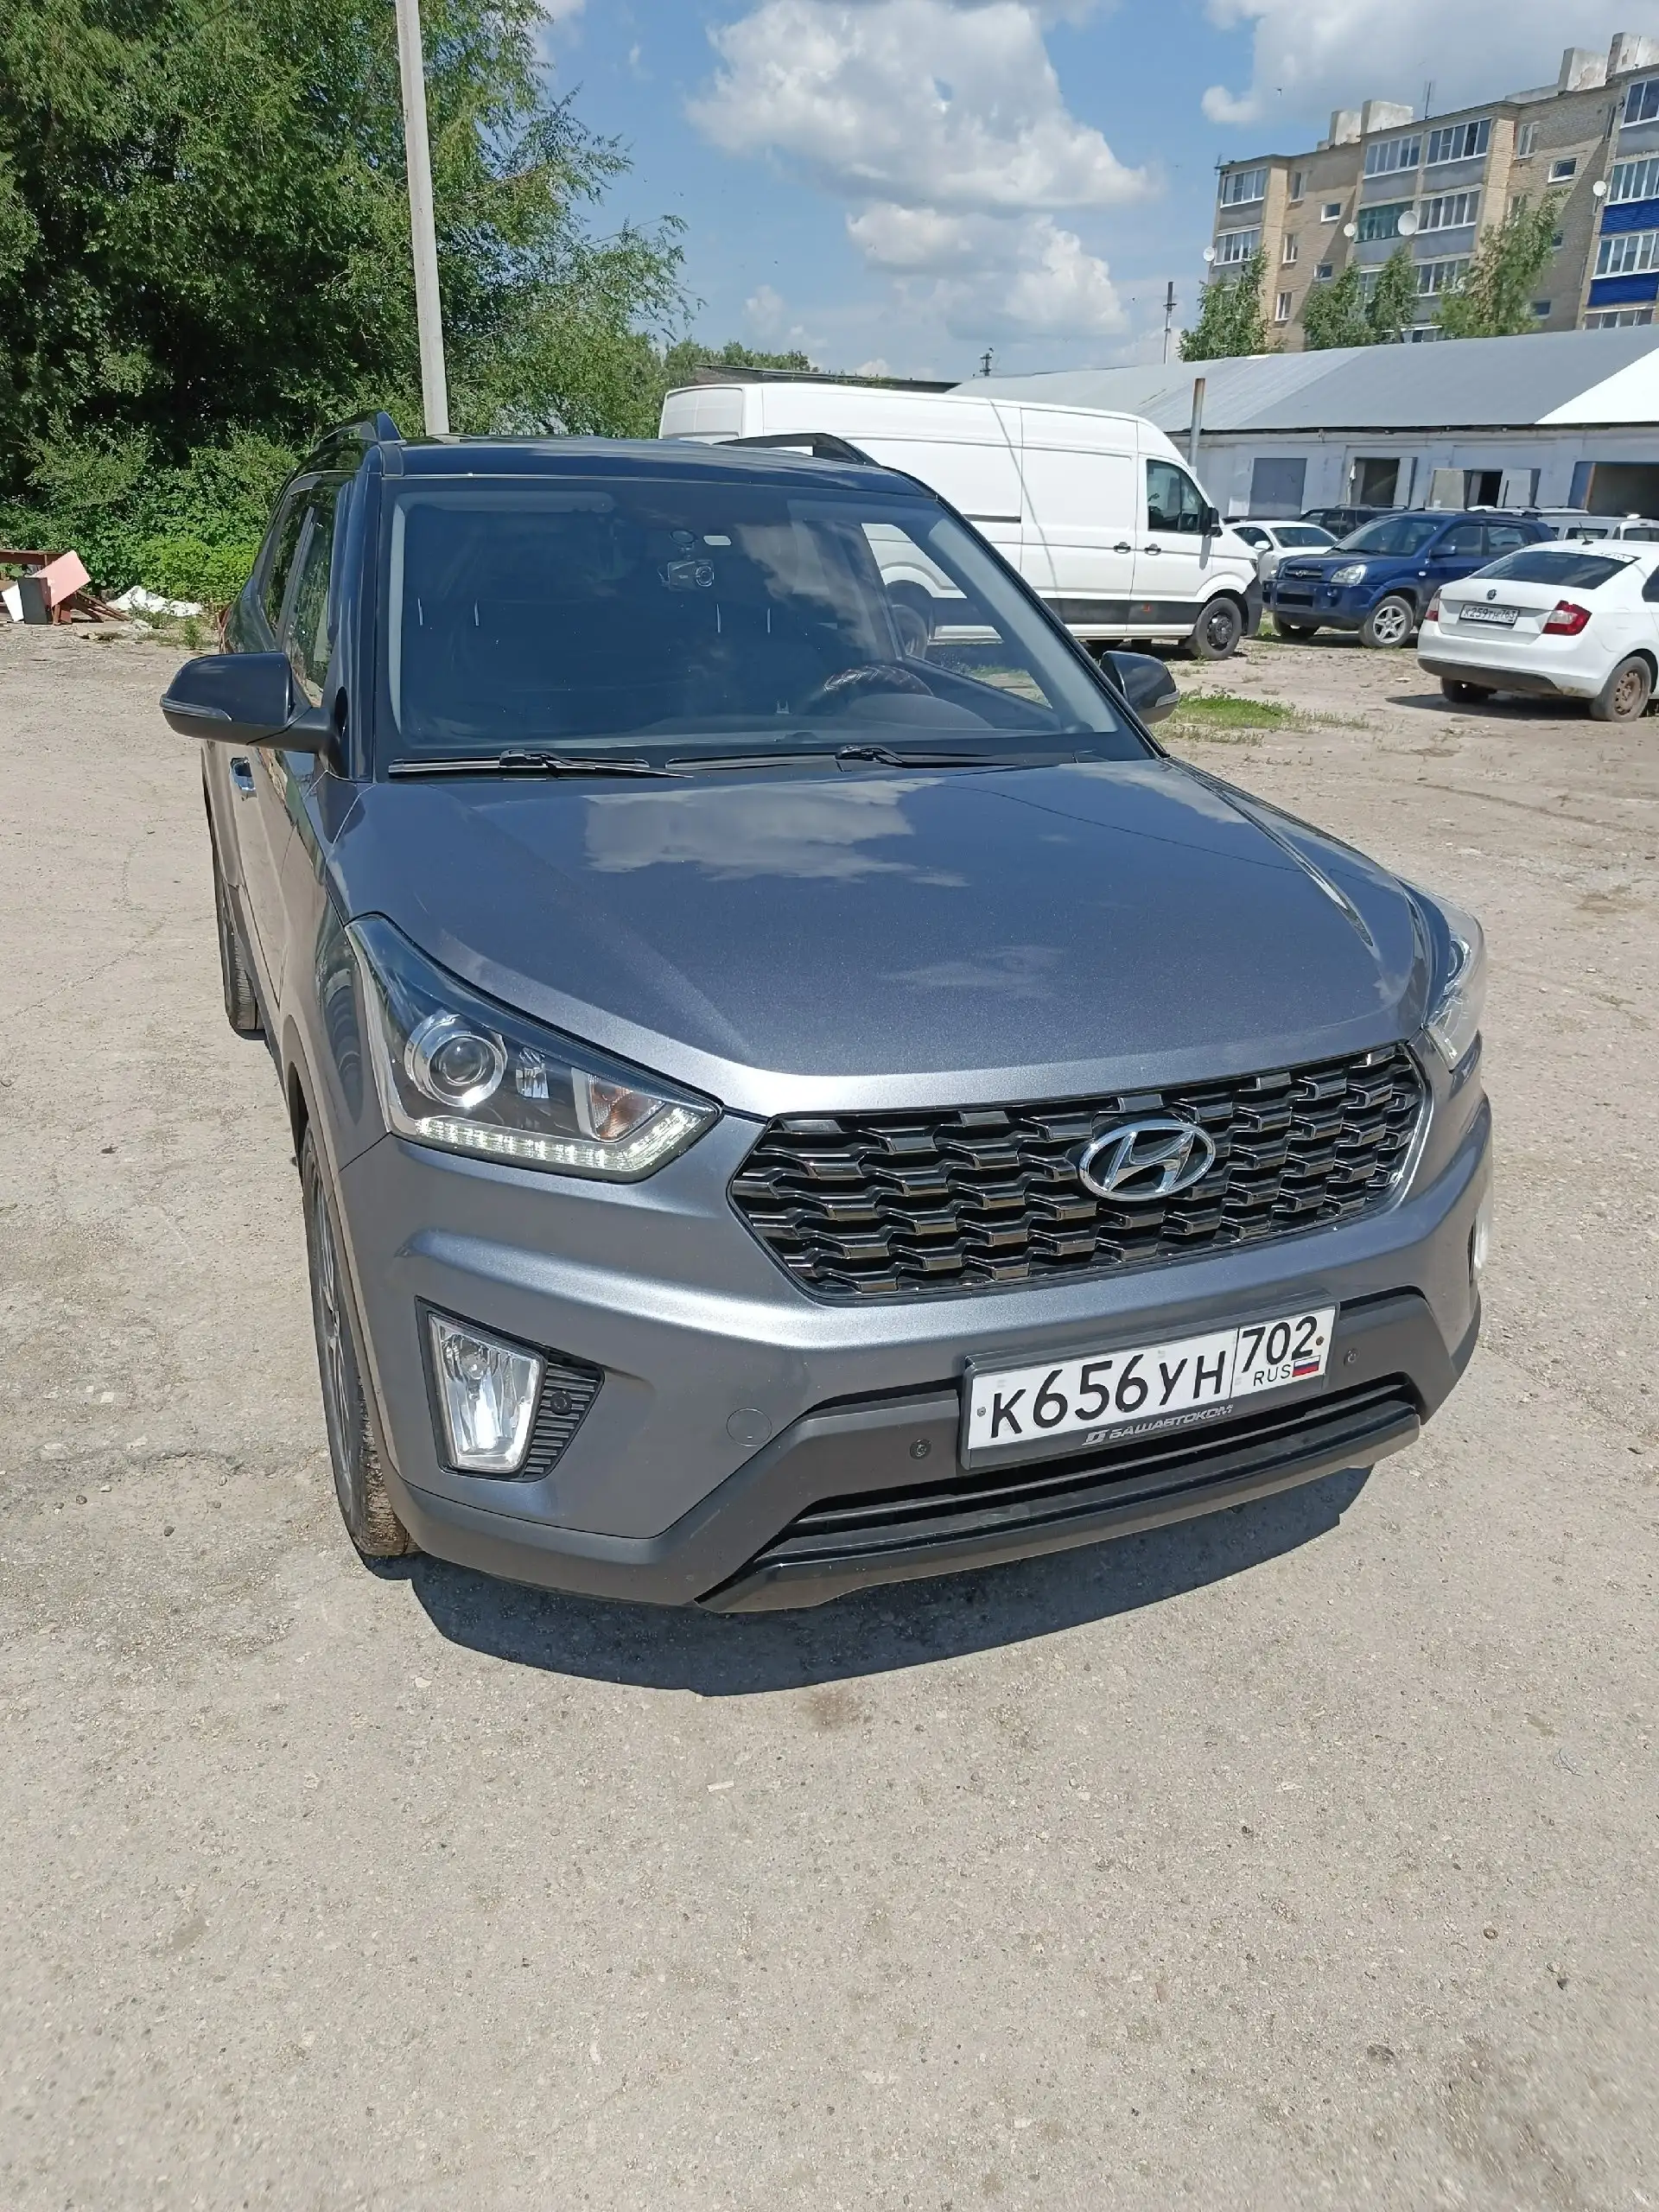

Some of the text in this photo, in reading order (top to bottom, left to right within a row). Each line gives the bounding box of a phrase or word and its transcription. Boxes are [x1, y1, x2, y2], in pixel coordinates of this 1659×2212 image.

[990, 1315, 1318, 1439] К656УН 702
[1253, 1364, 1291, 1386] RUS
